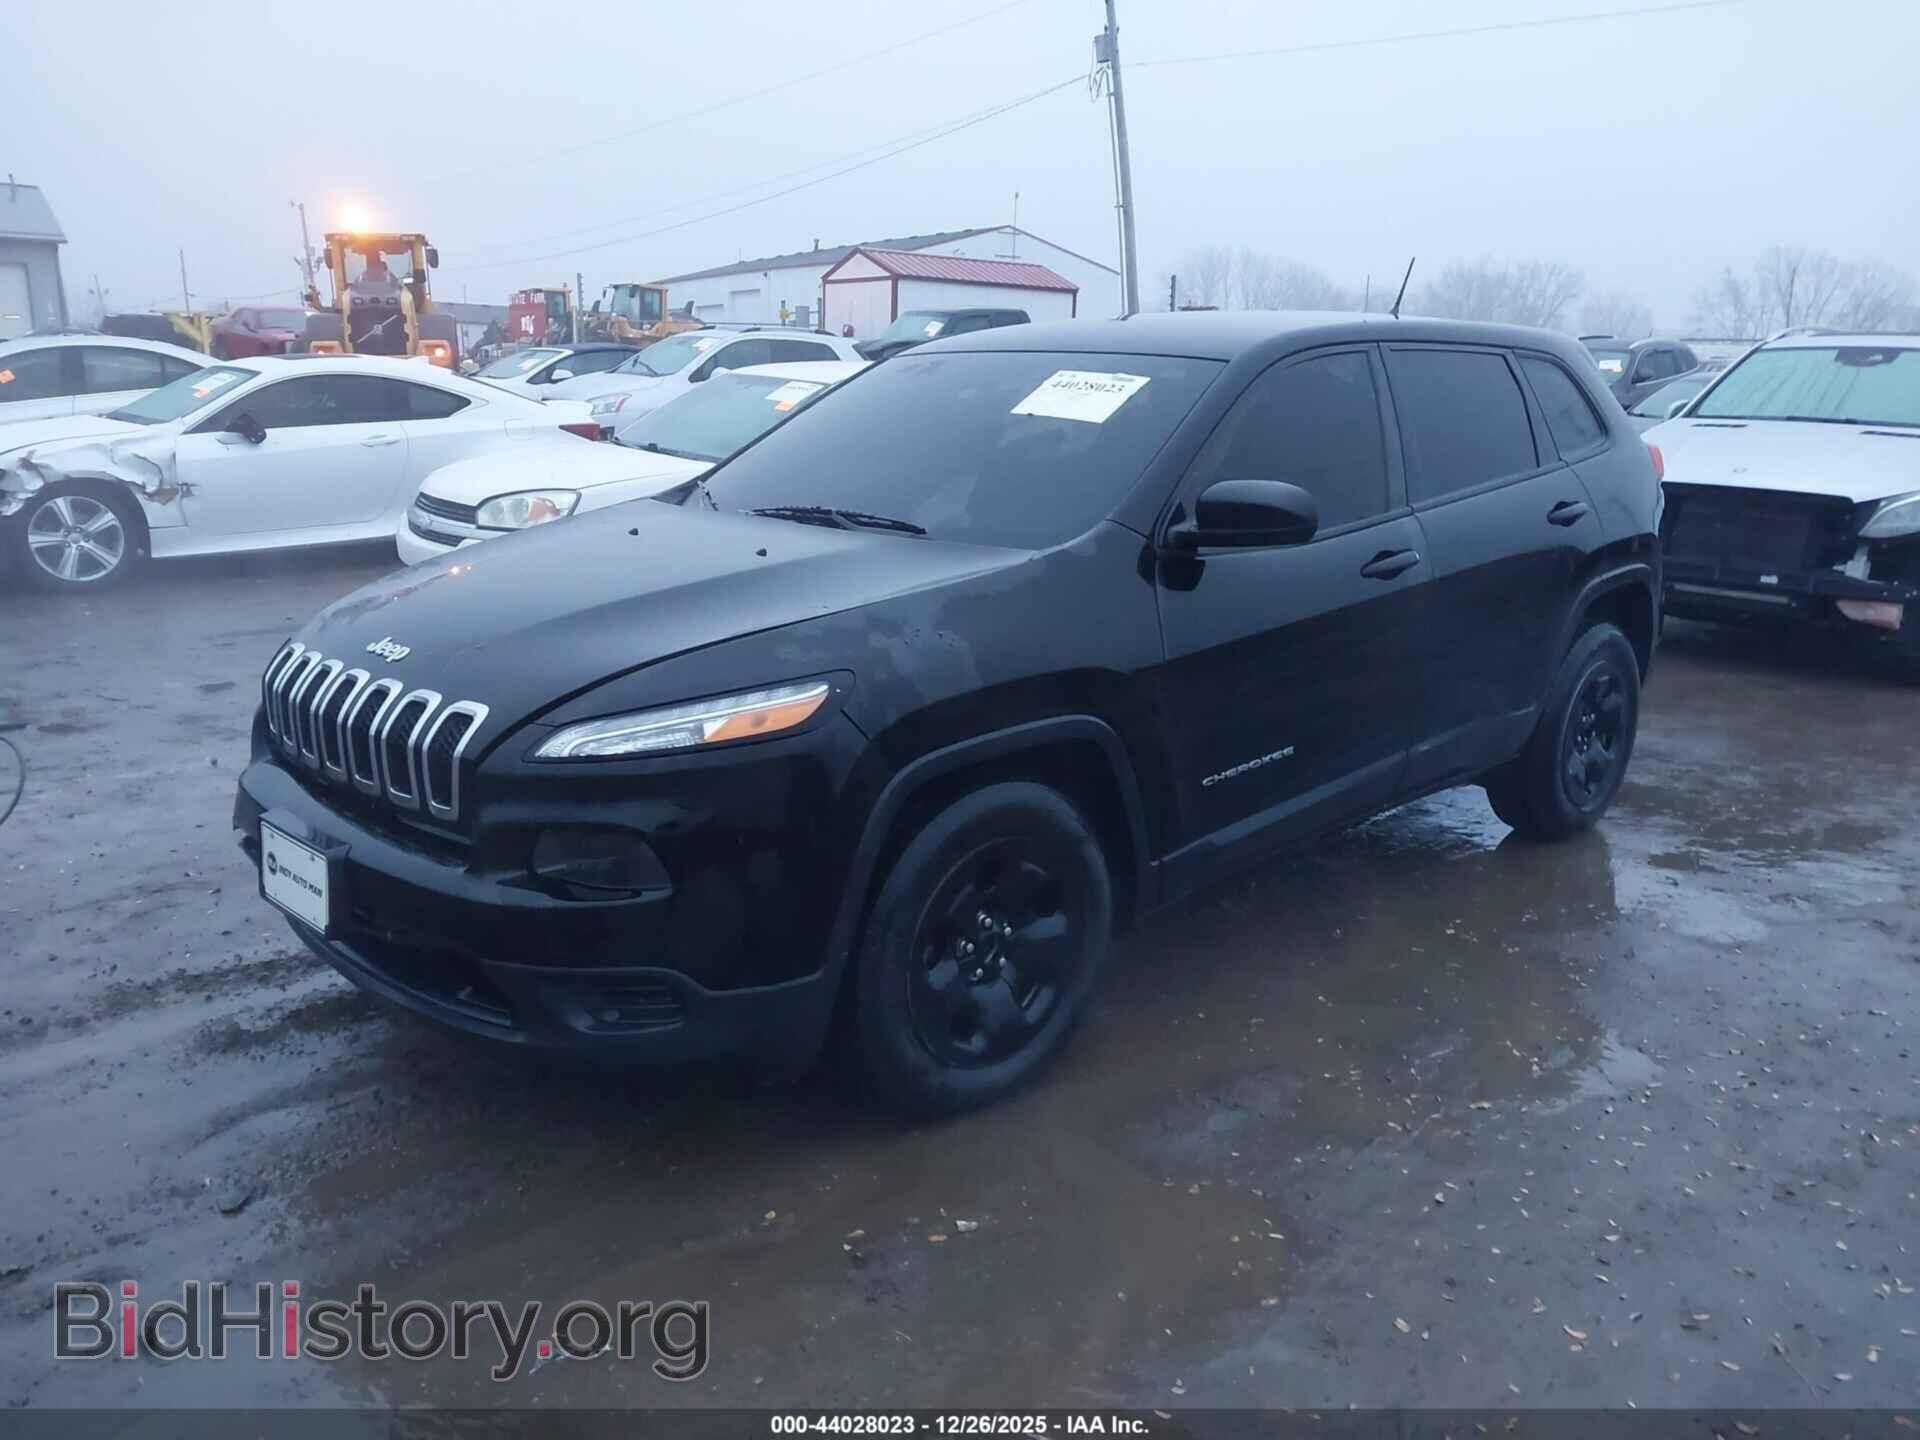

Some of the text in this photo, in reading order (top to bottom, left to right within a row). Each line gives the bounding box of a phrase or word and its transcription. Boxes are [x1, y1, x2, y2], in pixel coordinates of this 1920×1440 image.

[366, 636, 410, 663] Jeep
[1202, 745, 1294, 786] CHEROKEE
[292, 872, 308, 889] AUTO
[308, 883, 323, 898] MAN
